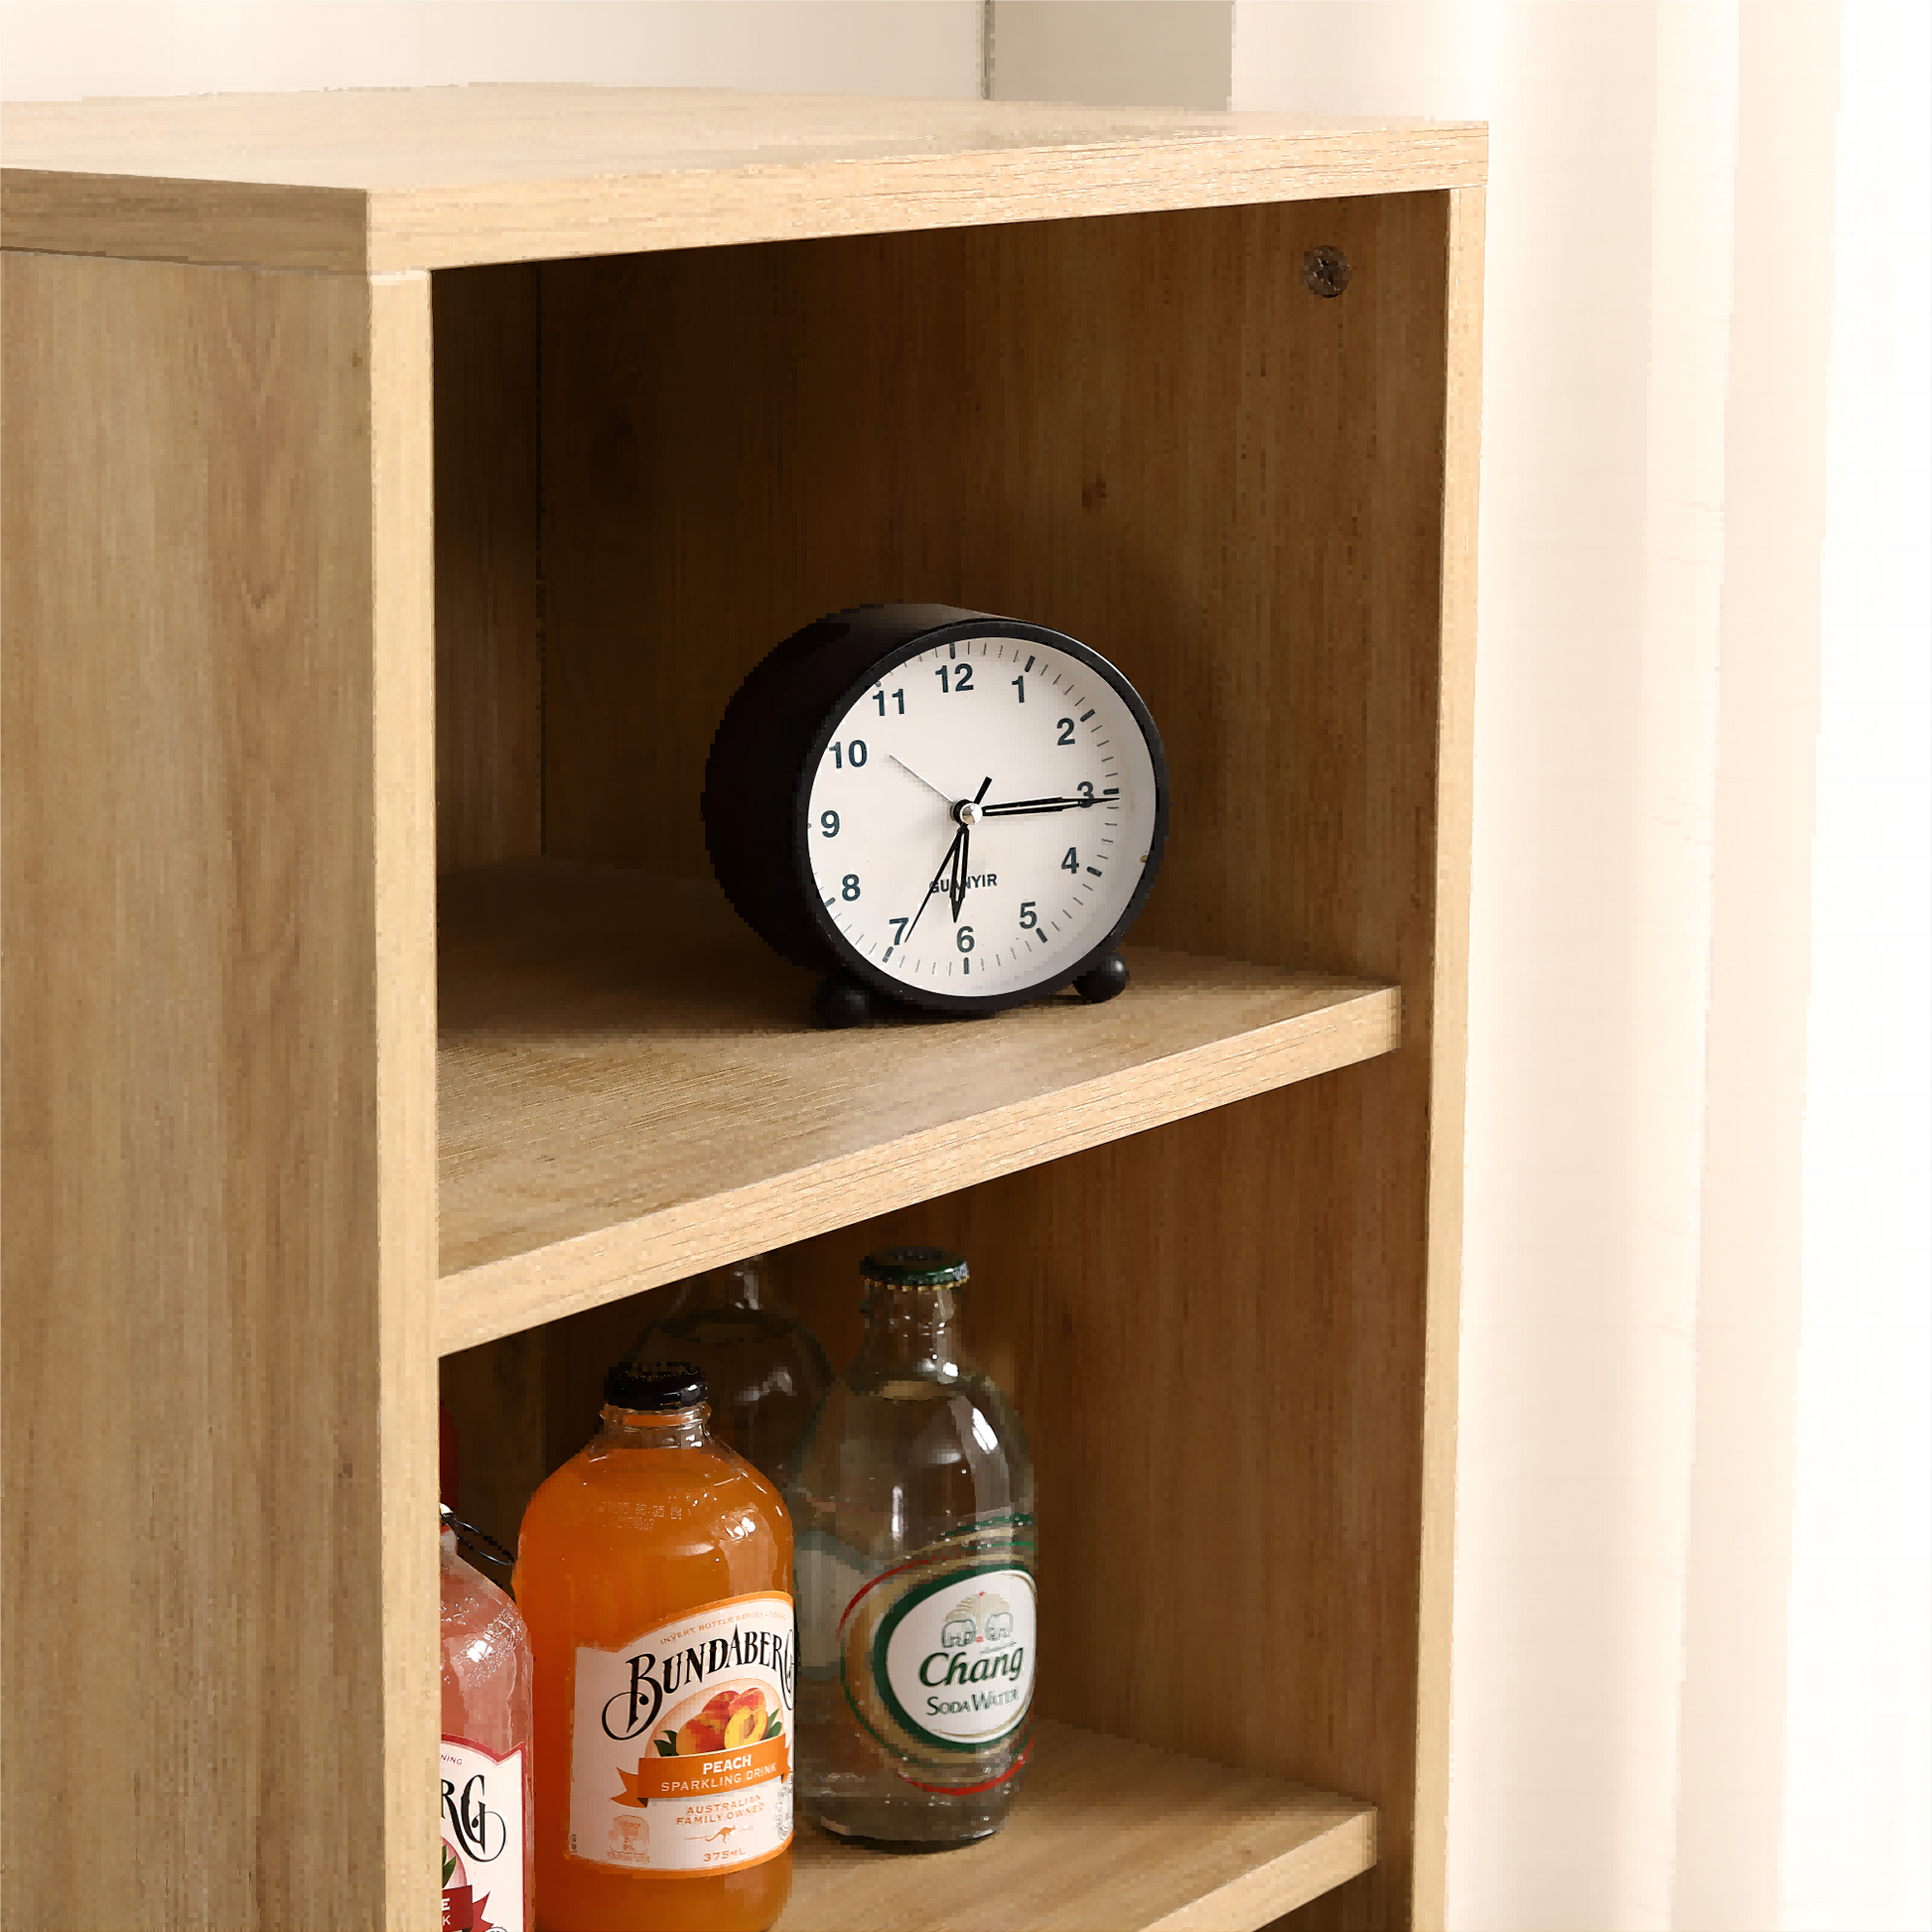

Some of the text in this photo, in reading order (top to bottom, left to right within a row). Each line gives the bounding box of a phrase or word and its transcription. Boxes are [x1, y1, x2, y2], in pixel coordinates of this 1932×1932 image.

[935, 663, 974, 693] 12
[1012, 676, 1026, 703] 1
[872, 689, 905, 717] 11
[1056, 718, 1075, 747] 2
[829, 740, 868, 768] 10
[1077, 781, 1095, 808] 3
[820, 810, 841, 838] 9
[1060, 847, 1080, 875] 4
[841, 874, 861, 901] 8
[1019, 901, 1037, 929] 5
[889, 917, 909, 946] 7
[956, 925, 975, 953] 6
[659, 1626, 696, 1645] INVERT
[698, 1615, 734, 1631] BOTTLE
[917, 1647, 1024, 1687] Chang
[660, 1762, 776, 1792] SPARKLING DRINK
[703, 1754, 752, 1775] PEACH
[676, 1814, 724, 1826] FAMILY
